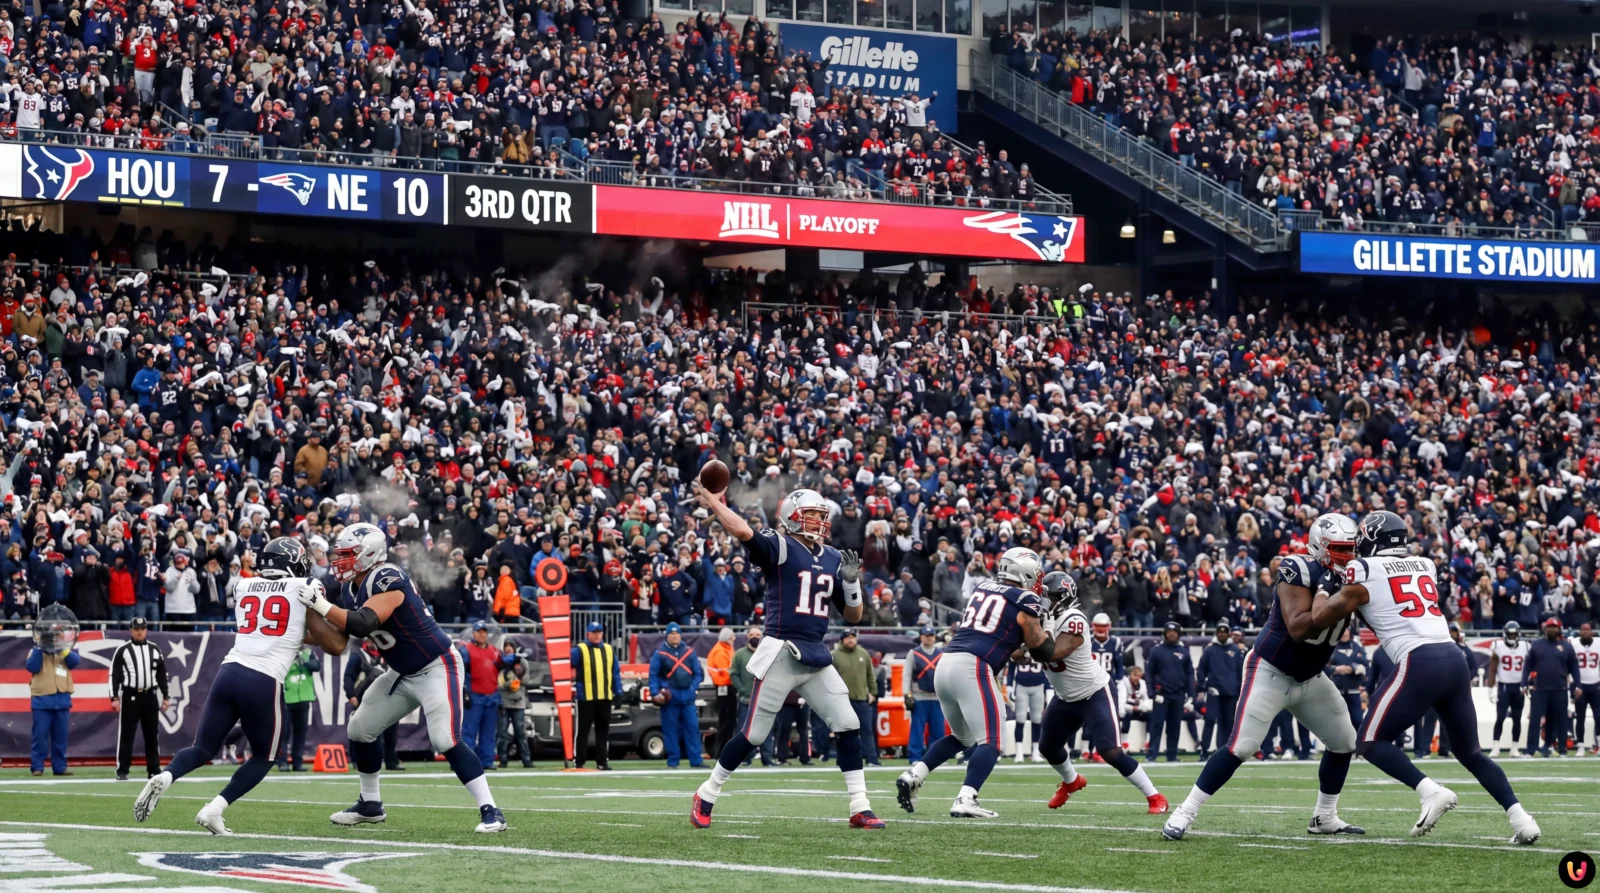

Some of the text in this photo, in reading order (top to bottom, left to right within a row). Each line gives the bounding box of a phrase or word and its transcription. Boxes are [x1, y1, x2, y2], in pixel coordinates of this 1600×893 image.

[820, 36, 919, 72] Gillette
[824, 70, 920, 92] STADIUM
[107, 158, 176, 198] HOU
[208, 165, 229, 203] 7
[327, 174, 369, 212] NE
[393, 178, 429, 217] 10
[464, 184, 572, 224] 3RD QTR
[719, 201, 880, 235] NHL PLAYOFF
[1353, 239, 1596, 278] GILLETTE STADIUM
[795, 570, 834, 617] 12
[1388, 574, 1442, 618] 59
[238, 595, 290, 637] 39
[958, 591, 1007, 634] 60
[1068, 621, 1084, 634] 99
[1501, 655, 1523, 672] 93
[876, 710, 891, 737] G
[322, 748, 346, 769] 20
